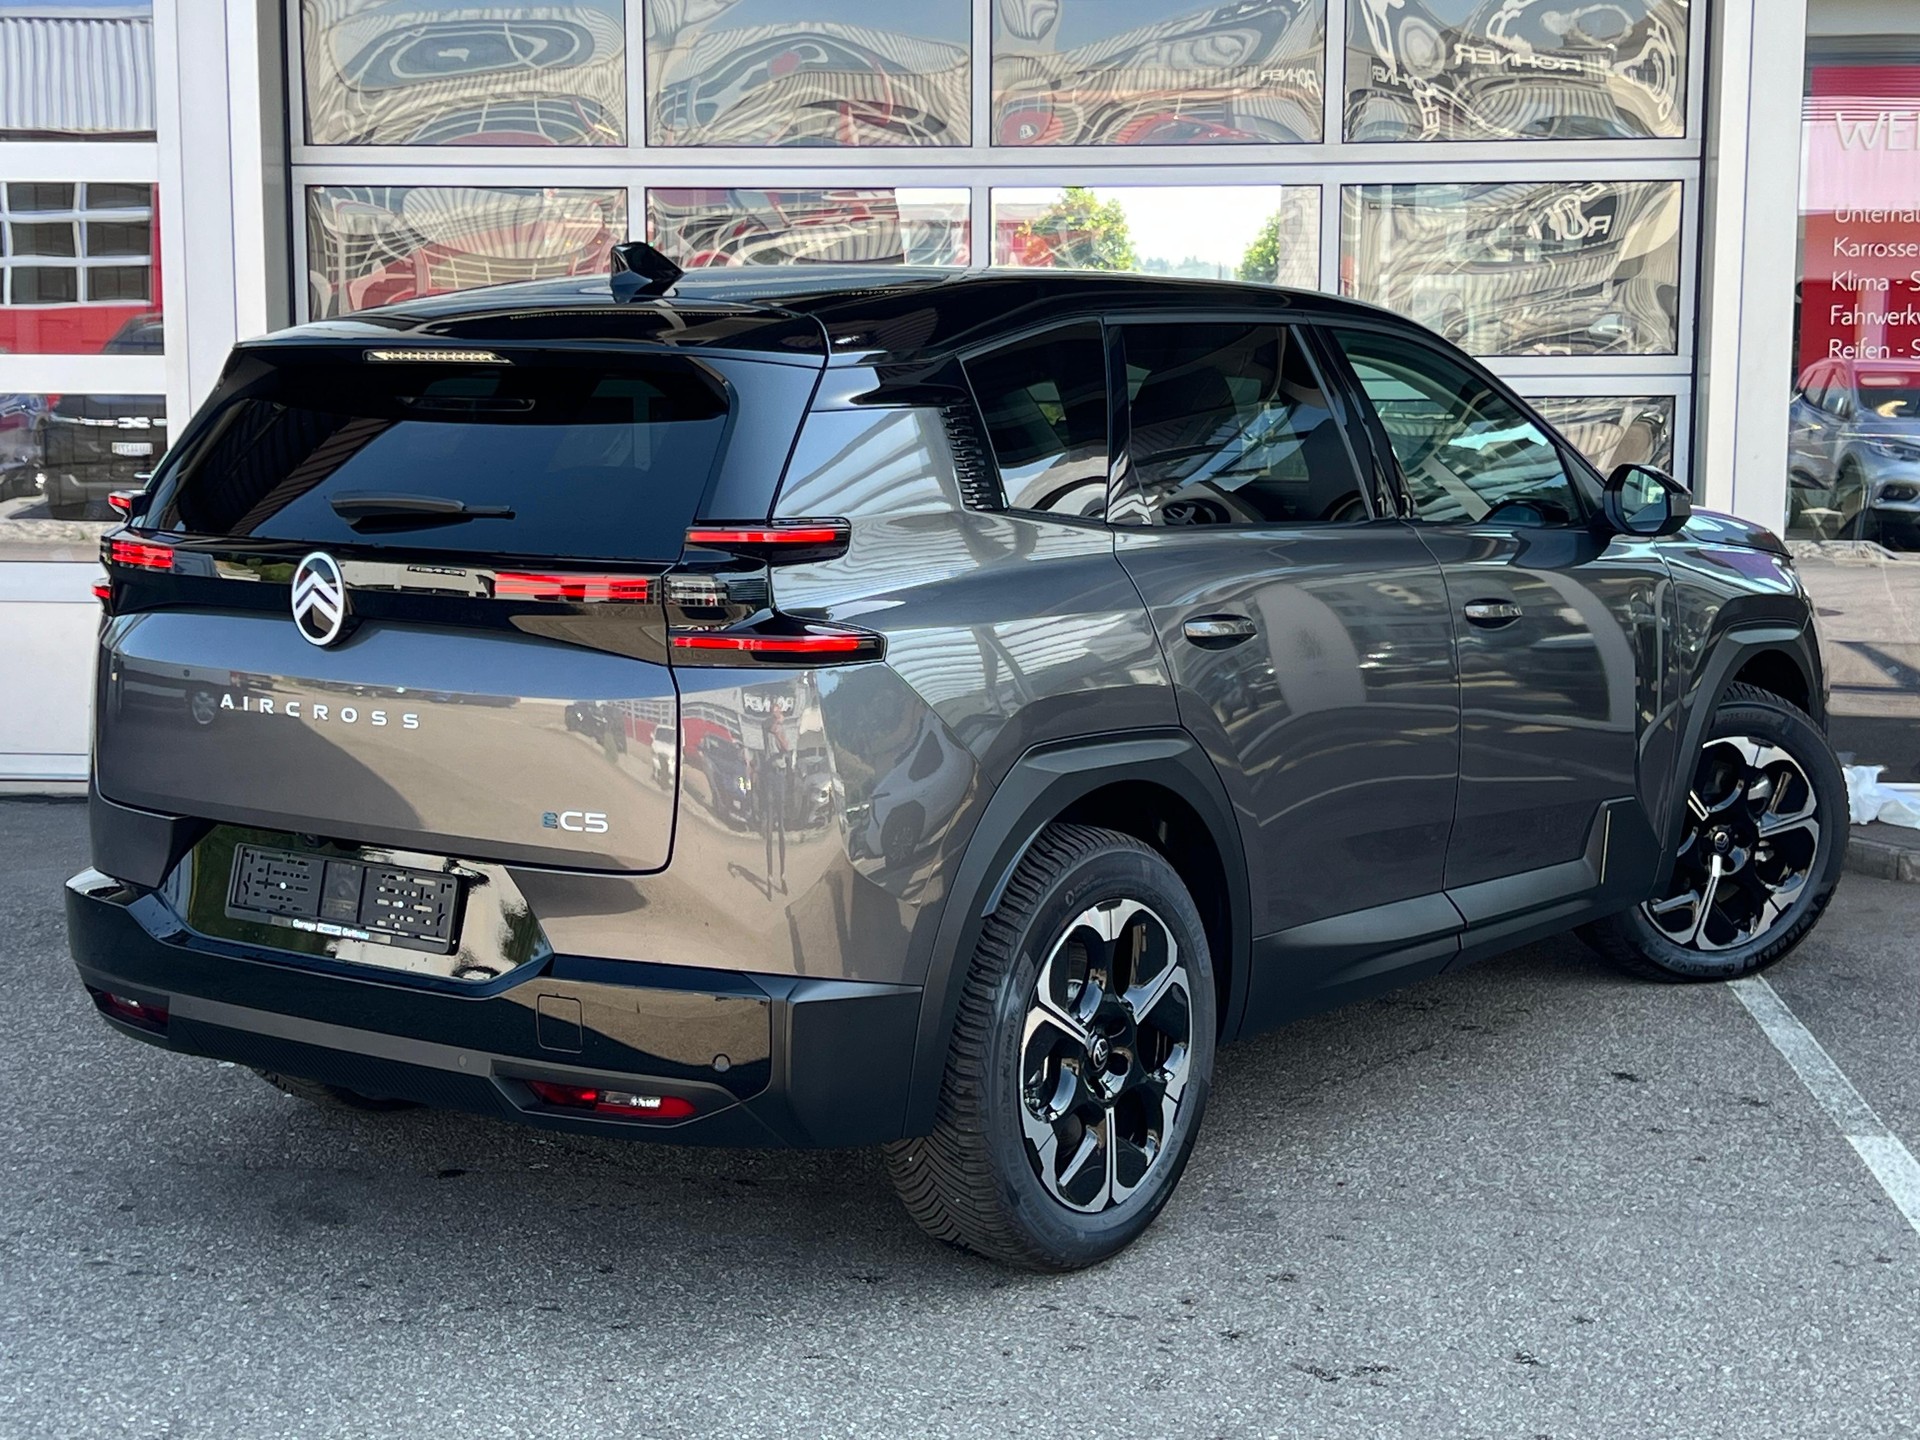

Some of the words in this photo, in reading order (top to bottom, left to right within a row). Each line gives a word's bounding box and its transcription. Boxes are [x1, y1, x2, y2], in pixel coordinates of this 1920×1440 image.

[1835, 111, 1920, 151] WE
[1833, 237, 1920, 257] Karrosse
[1832, 270, 1889, 291] Klima
[1828, 337, 1890, 359] Reifen
[220, 693, 420, 730] AIRCROSS
